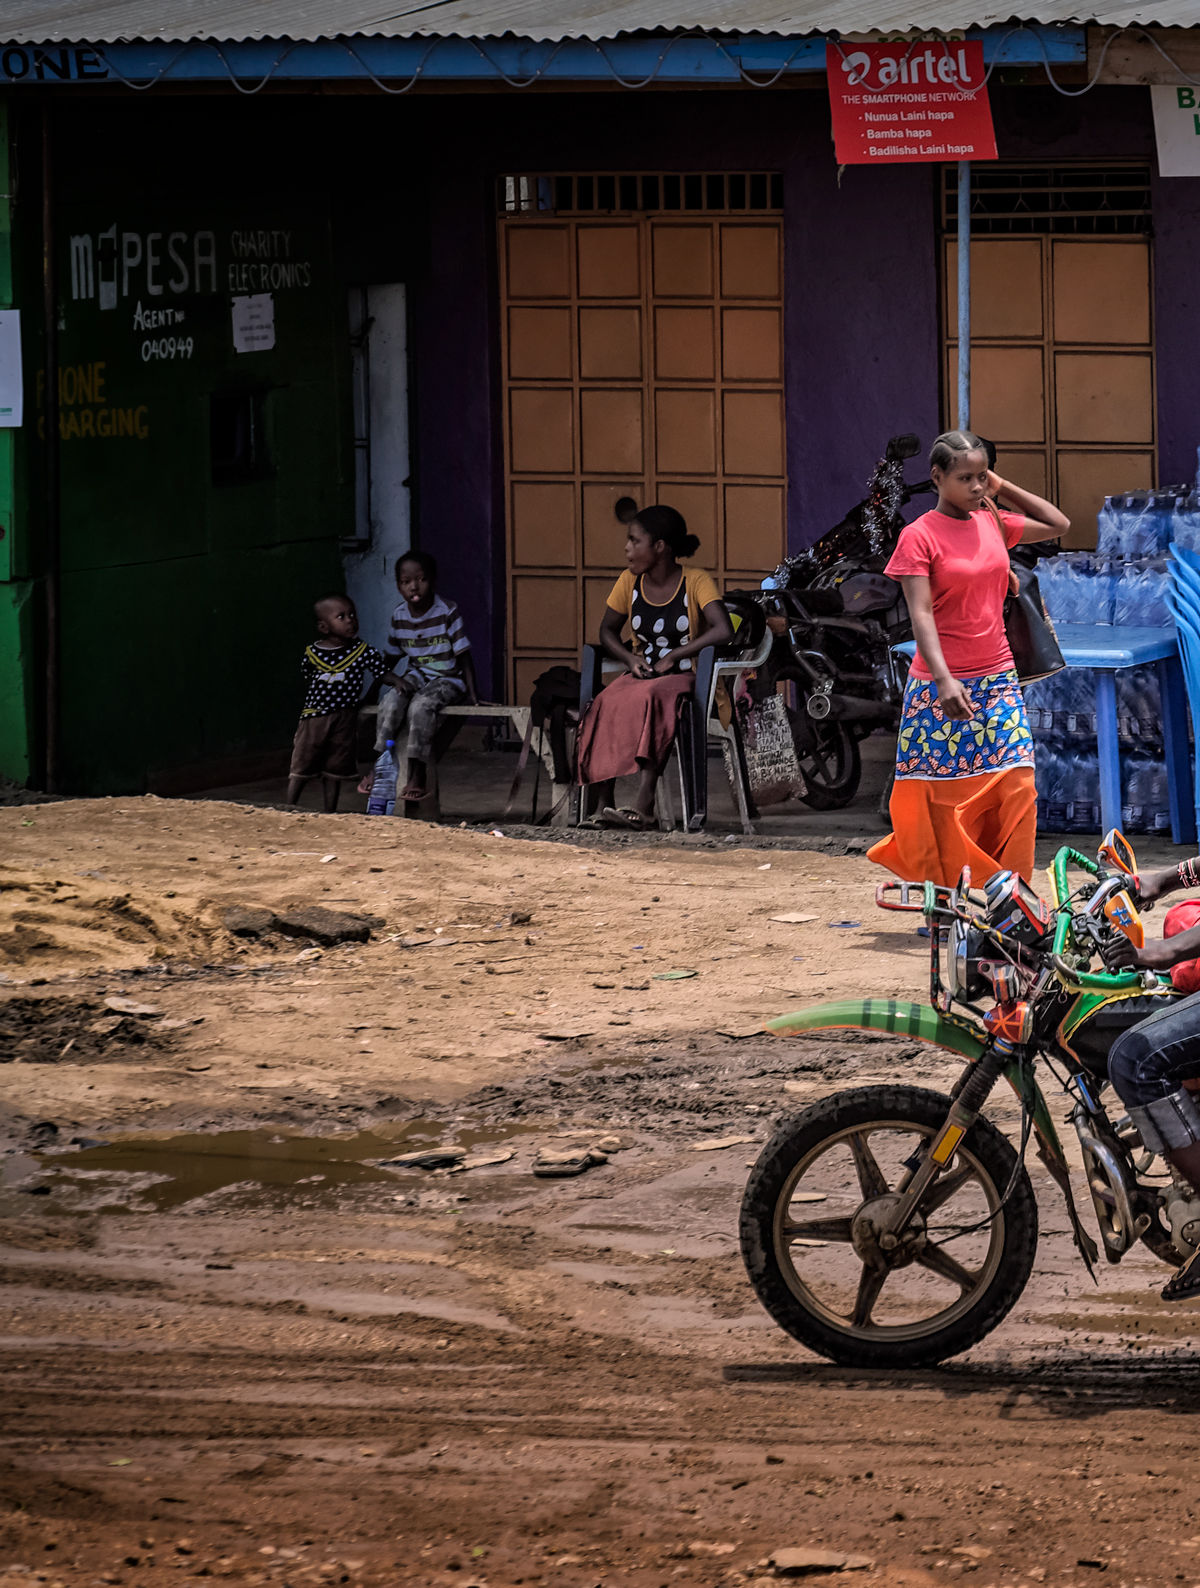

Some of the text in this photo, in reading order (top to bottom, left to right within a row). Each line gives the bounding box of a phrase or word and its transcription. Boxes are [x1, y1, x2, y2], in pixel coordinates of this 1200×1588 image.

[878, 49, 972, 85] airtel
[842, 91, 977, 104] THE SMARTPHONE NETWORK
[864, 109, 955, 122] Nunua Laini hapa
[866, 127, 932, 139] Bamba hapa
[869, 142, 975, 156] Badilisha Laini hapa
[232, 230, 295, 258] CHARITY
